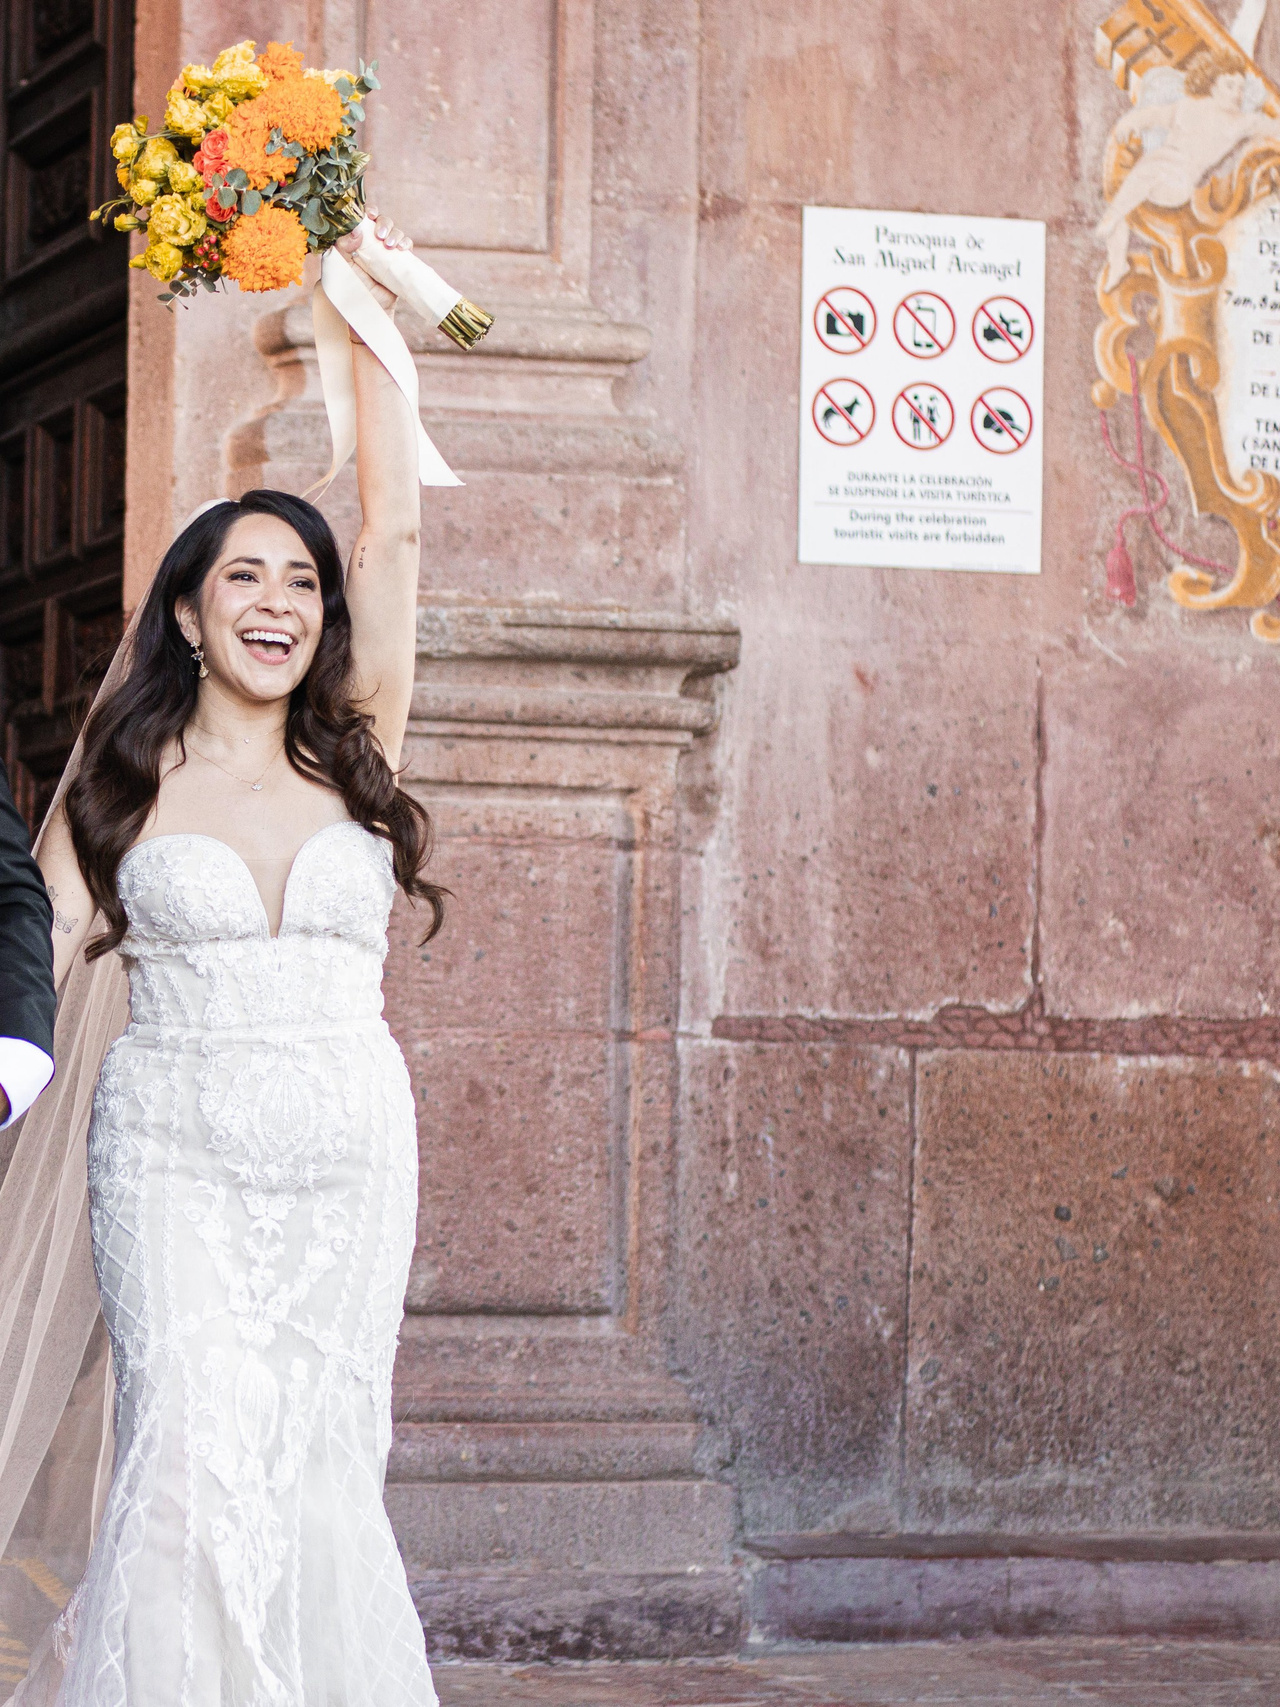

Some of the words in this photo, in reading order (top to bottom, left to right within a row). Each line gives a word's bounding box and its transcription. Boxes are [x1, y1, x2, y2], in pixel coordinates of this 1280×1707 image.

[875, 225, 956, 250] Parroquia
[966, 233, 985, 250] de
[833, 246, 865, 267] San
[874, 249, 936, 275] Miguel
[1253, 329, 1272, 345] DE
[1250, 382, 1269, 397] DE
[847, 471, 898, 483] DURANTE
[903, 473, 916, 483] LA
[919, 474, 992, 487] CELEBRACIÓN
[828, 485, 839, 496] SE
[844, 486, 898, 498] SUSPENDE
[903, 487, 916, 498] LA
[920, 489, 952, 500] VISITA
[849, 509, 891, 525] During
[896, 511, 915, 523] the
[919, 513, 987, 525] celebration
[834, 527, 882, 539] touristic
[889, 528, 918, 540] visits
[923, 532, 941, 542] are
[945, 530, 1005, 544] forbidden
